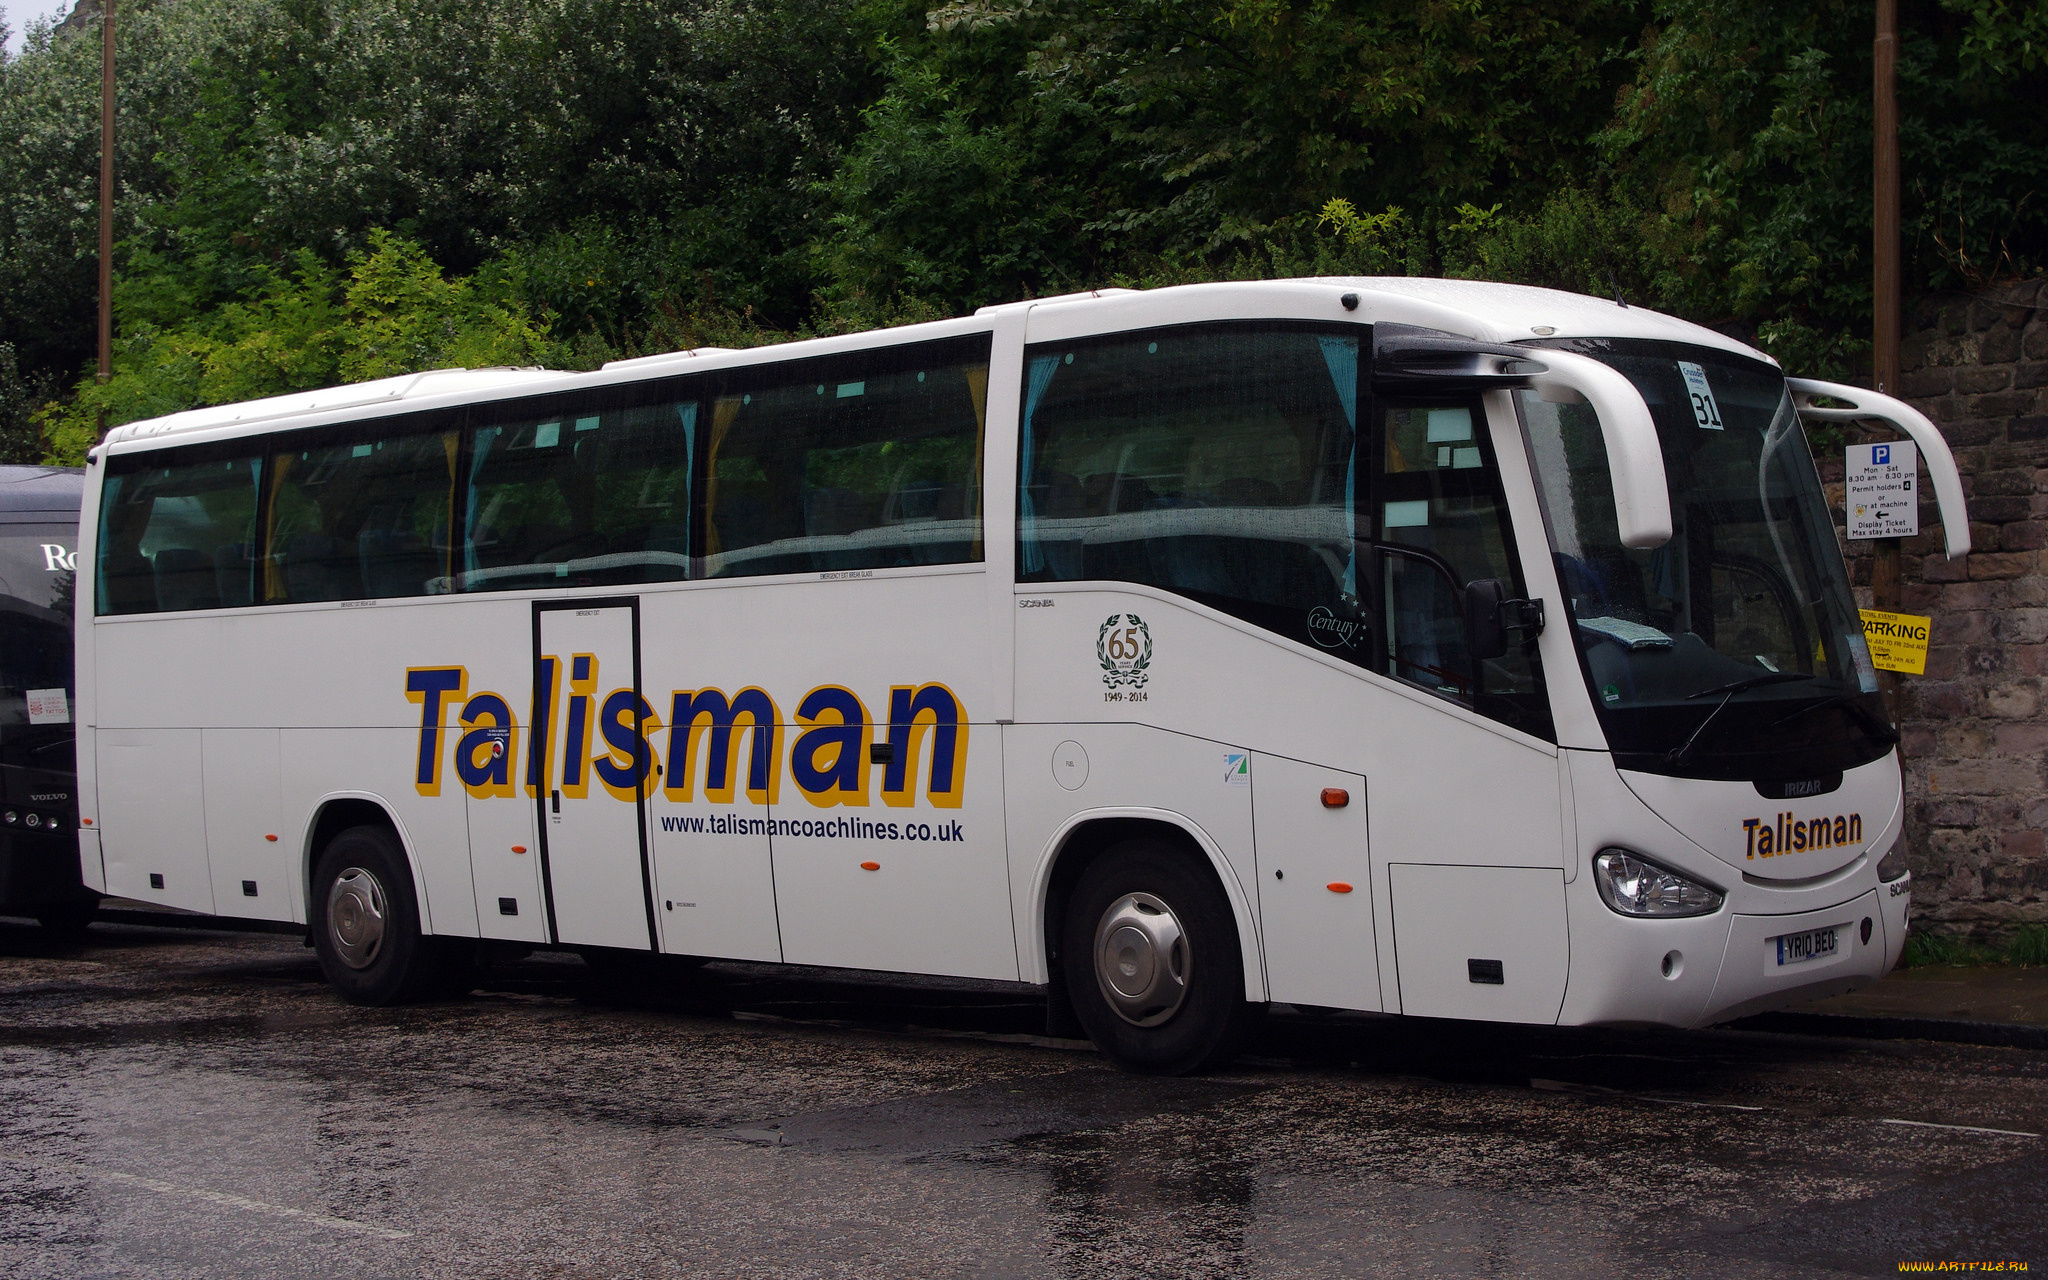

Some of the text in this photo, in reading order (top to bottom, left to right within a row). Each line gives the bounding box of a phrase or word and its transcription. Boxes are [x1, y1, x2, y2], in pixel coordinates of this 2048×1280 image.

[1691, 392, 1722, 427] 31
[1876, 447, 1888, 463] P
[1848, 475, 1865, 483] 8.30
[1885, 472, 1902, 480] 6.30
[1852, 485, 1874, 493] Permit
[1858, 519, 1906, 529] Display Ticket
[1868, 528, 1883, 536] stay
[1019, 599, 1055, 608] SCANIA
[1309, 612, 1359, 641] Century
[1108, 627, 1139, 660] 65
[1916, 643, 1927, 651] AUG
[1104, 692, 1123, 702] 1949
[1128, 692, 1149, 702] 2014
[405, 653, 969, 809] Talisman
[1784, 779, 1821, 797] IRIZAR
[30, 793, 68, 801] VOLVO
[661, 814, 964, 842] www.talismancoachlines.co.uk
[1742, 811, 1863, 860] Talisman
[1814, 929, 1835, 954] BEO
